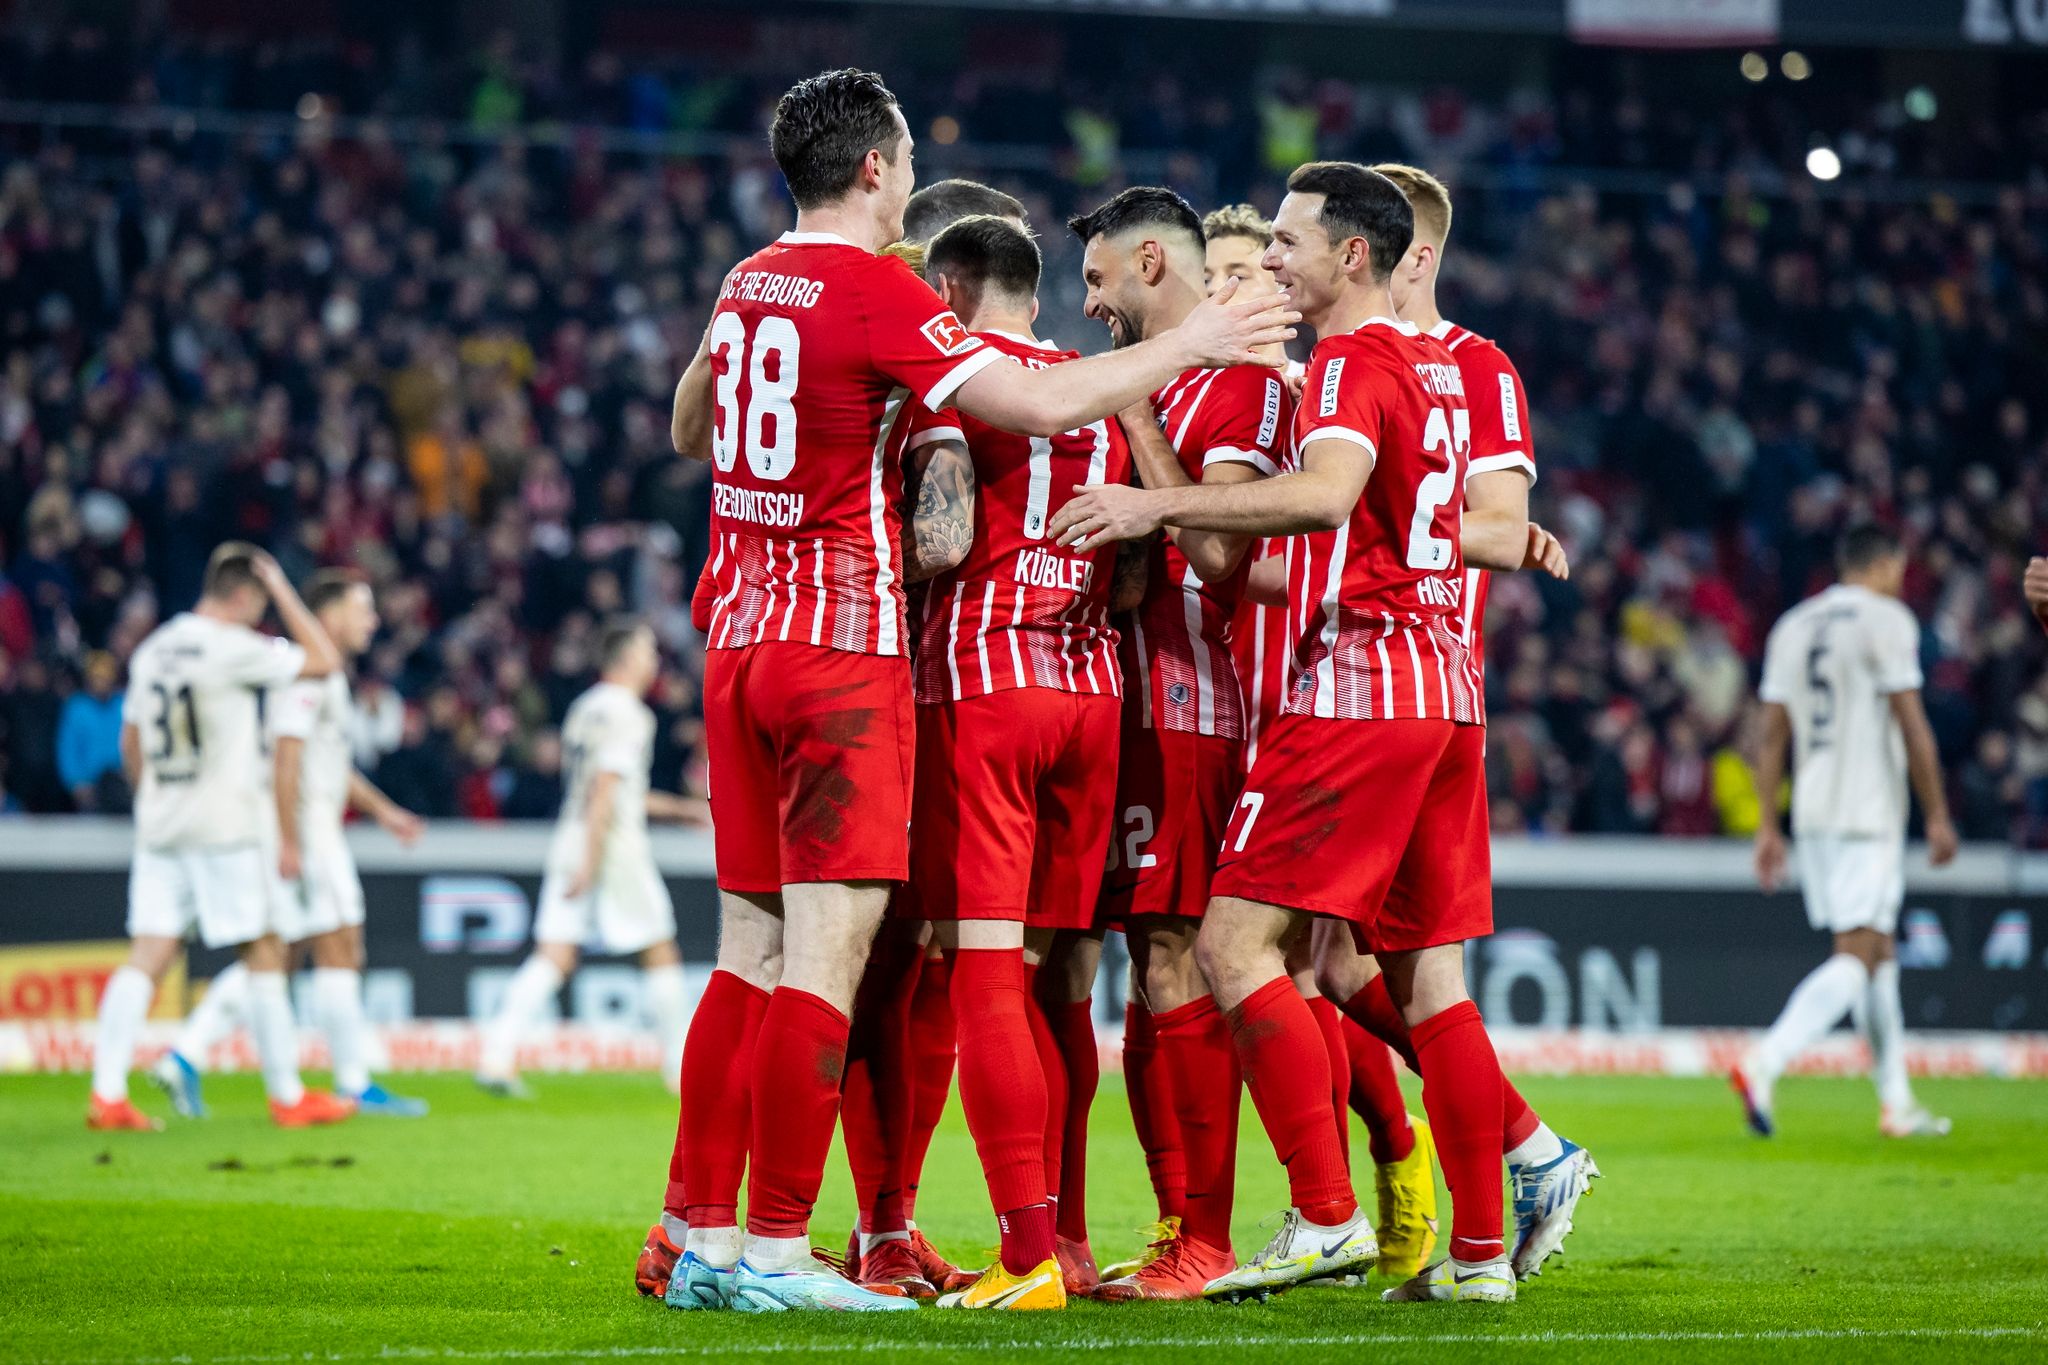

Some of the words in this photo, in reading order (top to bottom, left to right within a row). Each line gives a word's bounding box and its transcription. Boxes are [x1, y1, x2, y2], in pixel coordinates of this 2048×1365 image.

[735, 271, 825, 308] FREIBURG
[710, 311, 801, 481] 38
[1259, 380, 1279, 444] BABISTA
[1323, 359, 1342, 415] BABISTA
[1502, 376, 1518, 438] BABISTA
[1014, 546, 1094, 595] KÜBLER
[150, 682, 202, 760] 31
